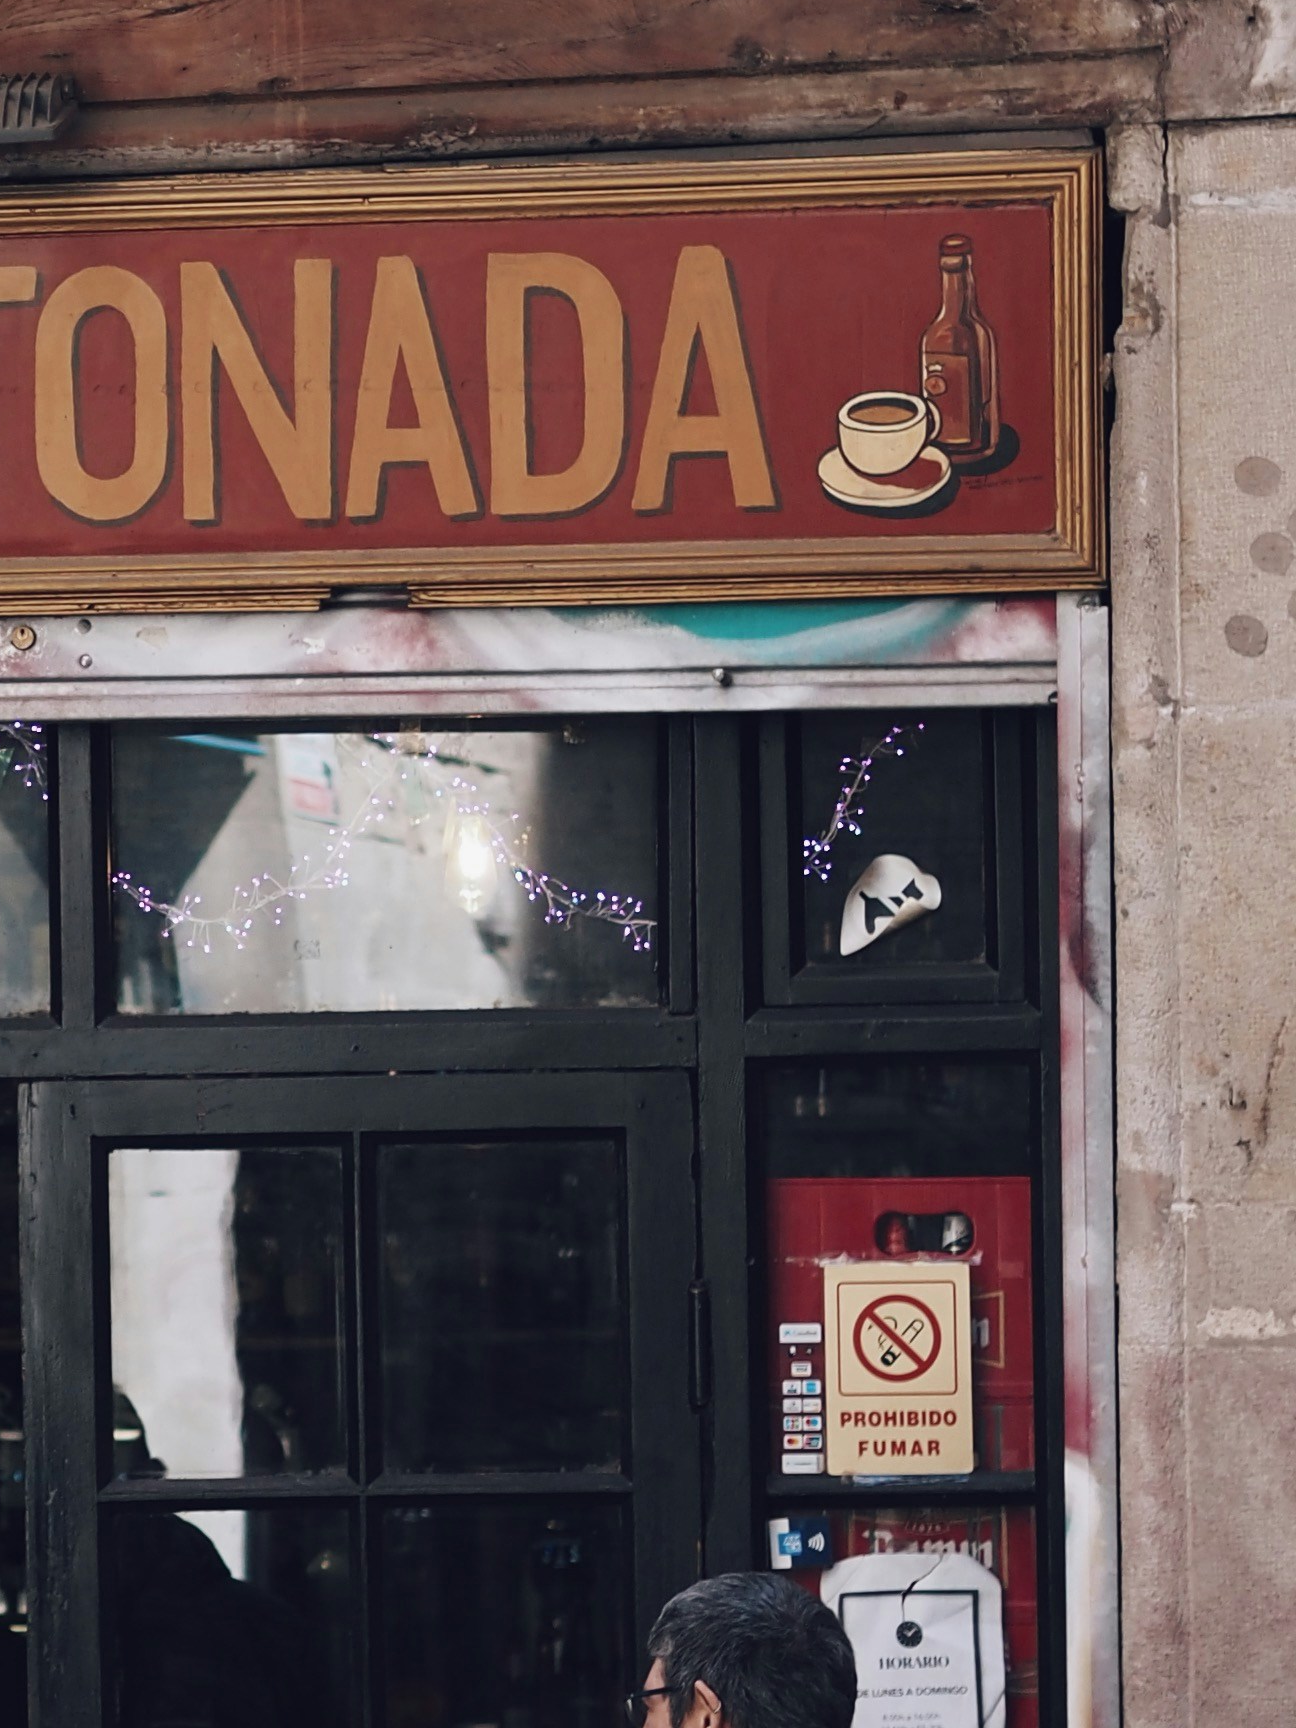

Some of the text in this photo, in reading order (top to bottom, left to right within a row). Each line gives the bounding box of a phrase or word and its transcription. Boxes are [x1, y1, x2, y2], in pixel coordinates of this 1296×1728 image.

[840, 1409, 957, 1428] PROHIBIDO
[858, 1440, 941, 1457] FUMAR
[879, 1655, 950, 1670] HORARIO
[872, 1687, 904, 1698] LUNES
[916, 1685, 968, 1696] DOMINGO
